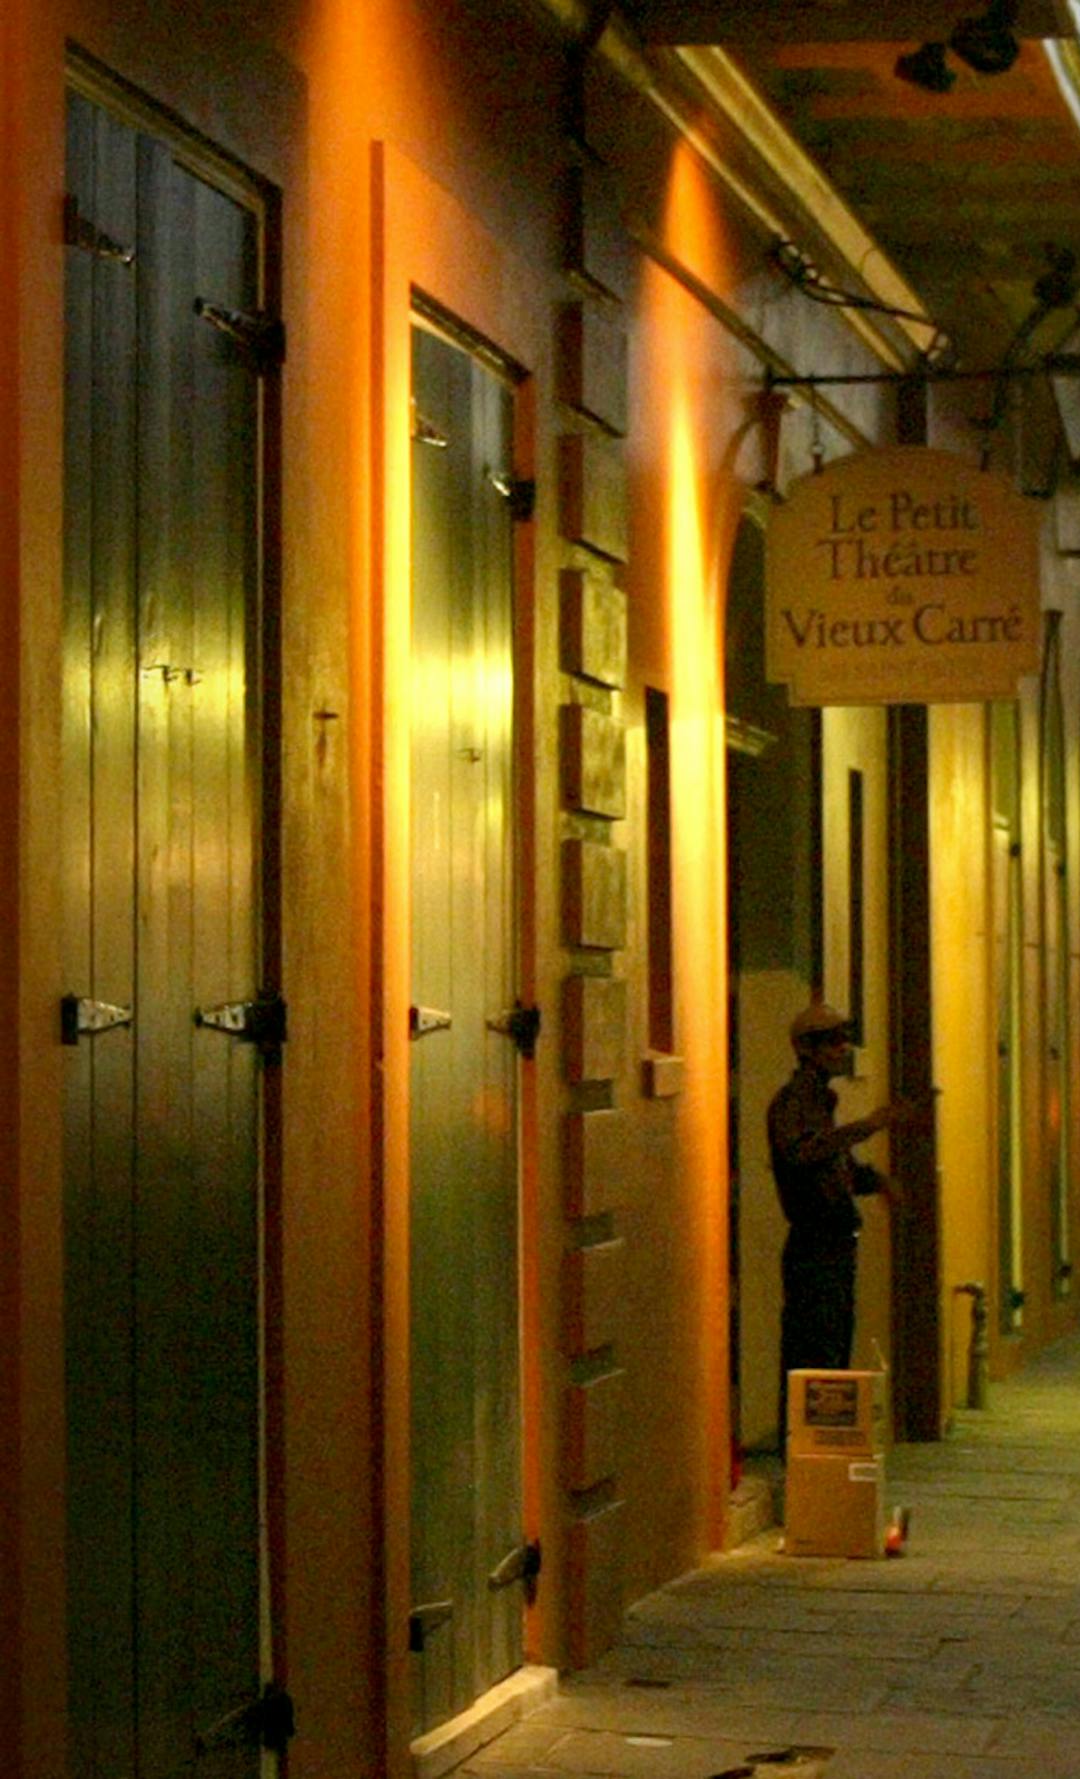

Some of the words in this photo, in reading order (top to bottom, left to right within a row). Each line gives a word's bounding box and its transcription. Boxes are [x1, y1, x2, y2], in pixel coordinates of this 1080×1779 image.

[829, 494, 876, 534] Le
[889, 490, 981, 532] Petit
[816, 537, 977, 580] Théâtre
[781, 607, 906, 648] Vieux
[913, 603, 1025, 646] Carré
